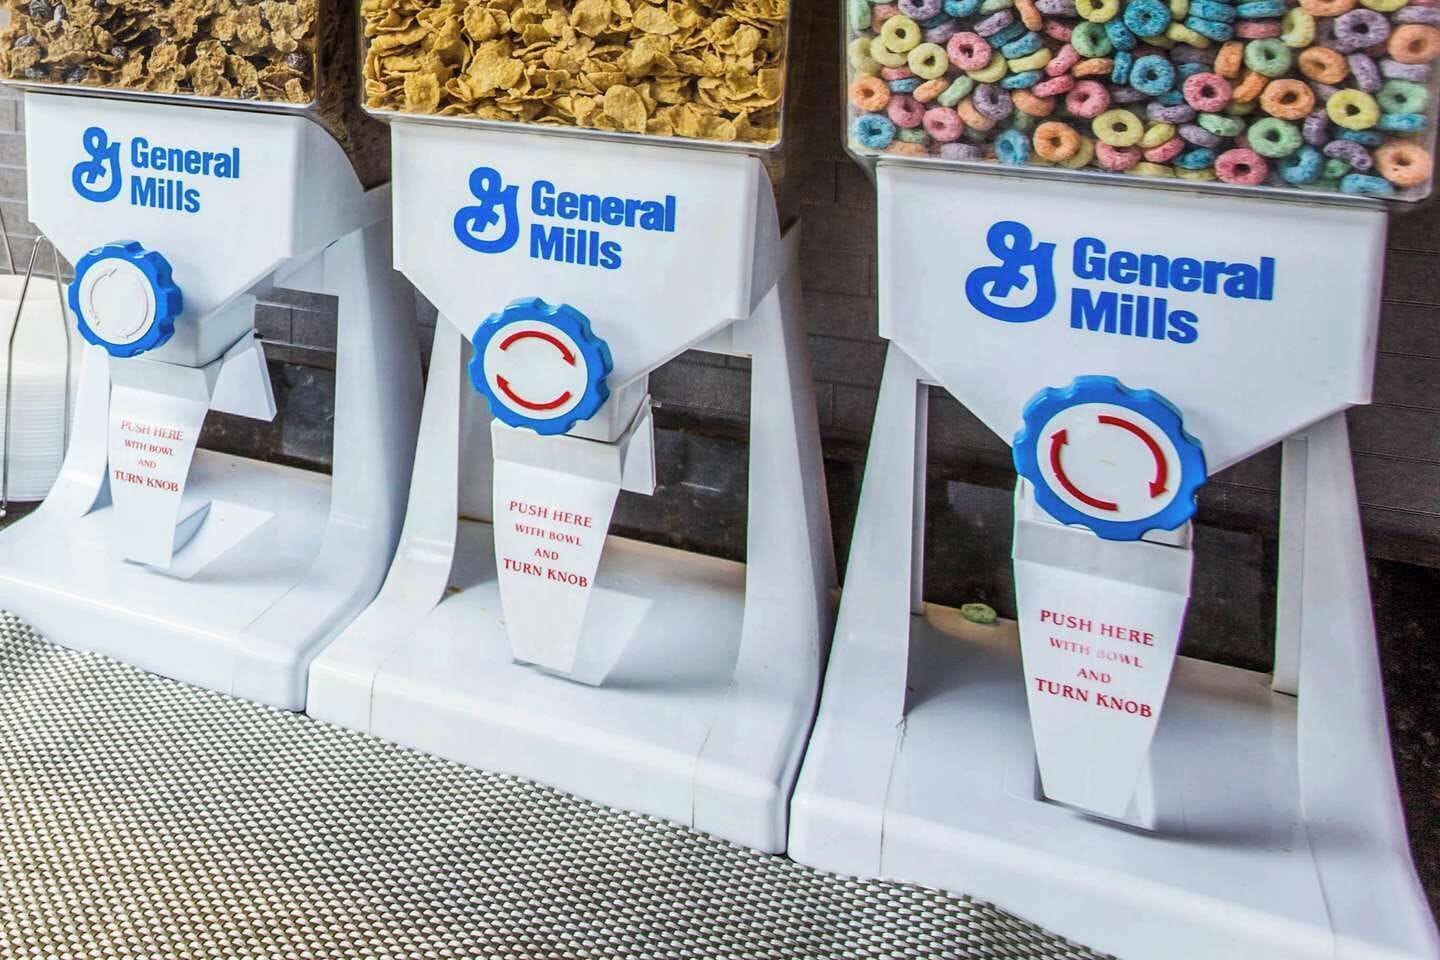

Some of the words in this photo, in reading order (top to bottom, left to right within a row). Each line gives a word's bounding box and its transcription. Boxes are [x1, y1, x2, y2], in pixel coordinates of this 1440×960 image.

[130, 136, 240, 179] General
[130, 175, 201, 213] Mills
[531, 179, 676, 233] General
[529, 223, 622, 270] Mills
[1072, 237, 1275, 302] General
[1070, 287, 1199, 344] Mills
[121, 419, 150, 435] PUSH
[153, 427, 184, 441] HERE
[124, 439, 146, 450] WITH
[149, 444, 174, 456] BOWL
[138, 458, 157, 469] AND
[114, 470, 144, 484] TURN
[146, 477, 179, 492] KNOB
[509, 500, 548, 519] PUSH
[553, 510, 592, 529] HERE
[515, 523, 545, 538] WITH
[549, 531, 582, 547] BOWL
[534, 548, 559, 560] AND
[504, 558, 543, 576] TURN
[547, 568, 588, 587] KNOB
[1040, 609, 1092, 632] PUSH
[1100, 623, 1154, 647] HERE
[1049, 637, 1090, 655] WITH
[1077, 668, 1112, 684] AND
[1035, 678, 1089, 702] TURN
[1096, 693, 1152, 718] KNOB
